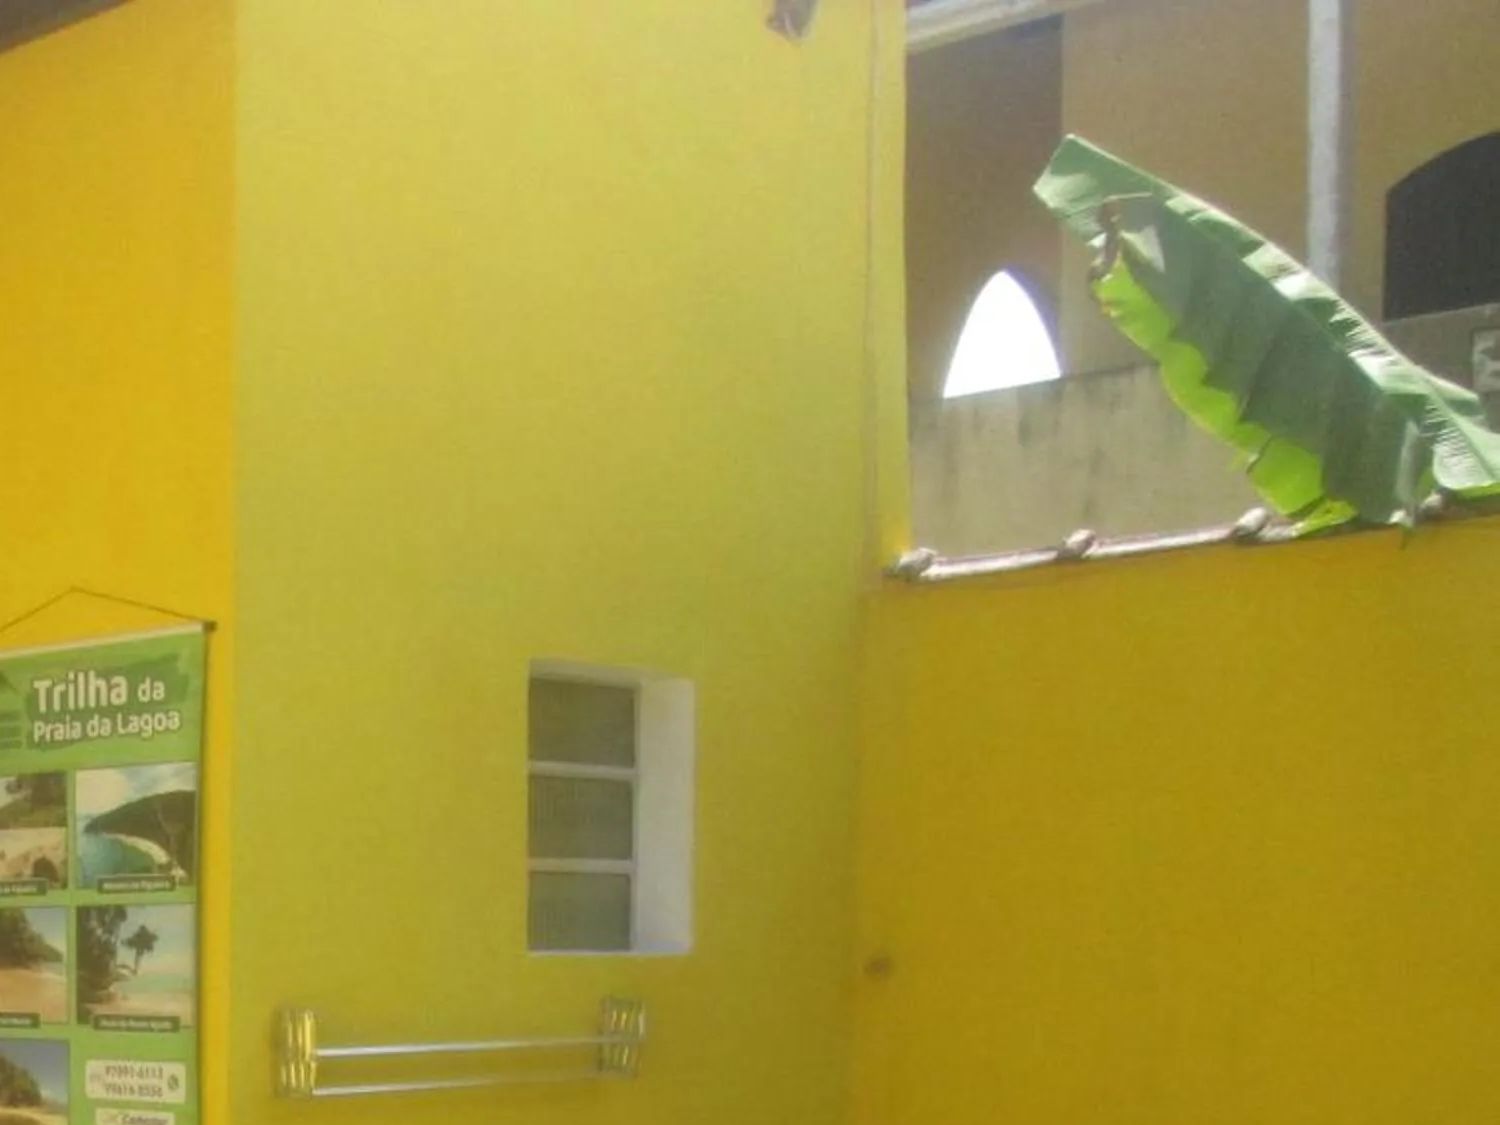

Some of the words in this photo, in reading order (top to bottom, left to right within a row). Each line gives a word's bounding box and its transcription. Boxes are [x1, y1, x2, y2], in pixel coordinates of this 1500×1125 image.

[33, 670, 128, 714] Trilha
[137, 676, 165, 702] da
[33, 714, 82, 743] Praia
[86, 713, 112, 737] da
[117, 710, 180, 739] Lagoa
